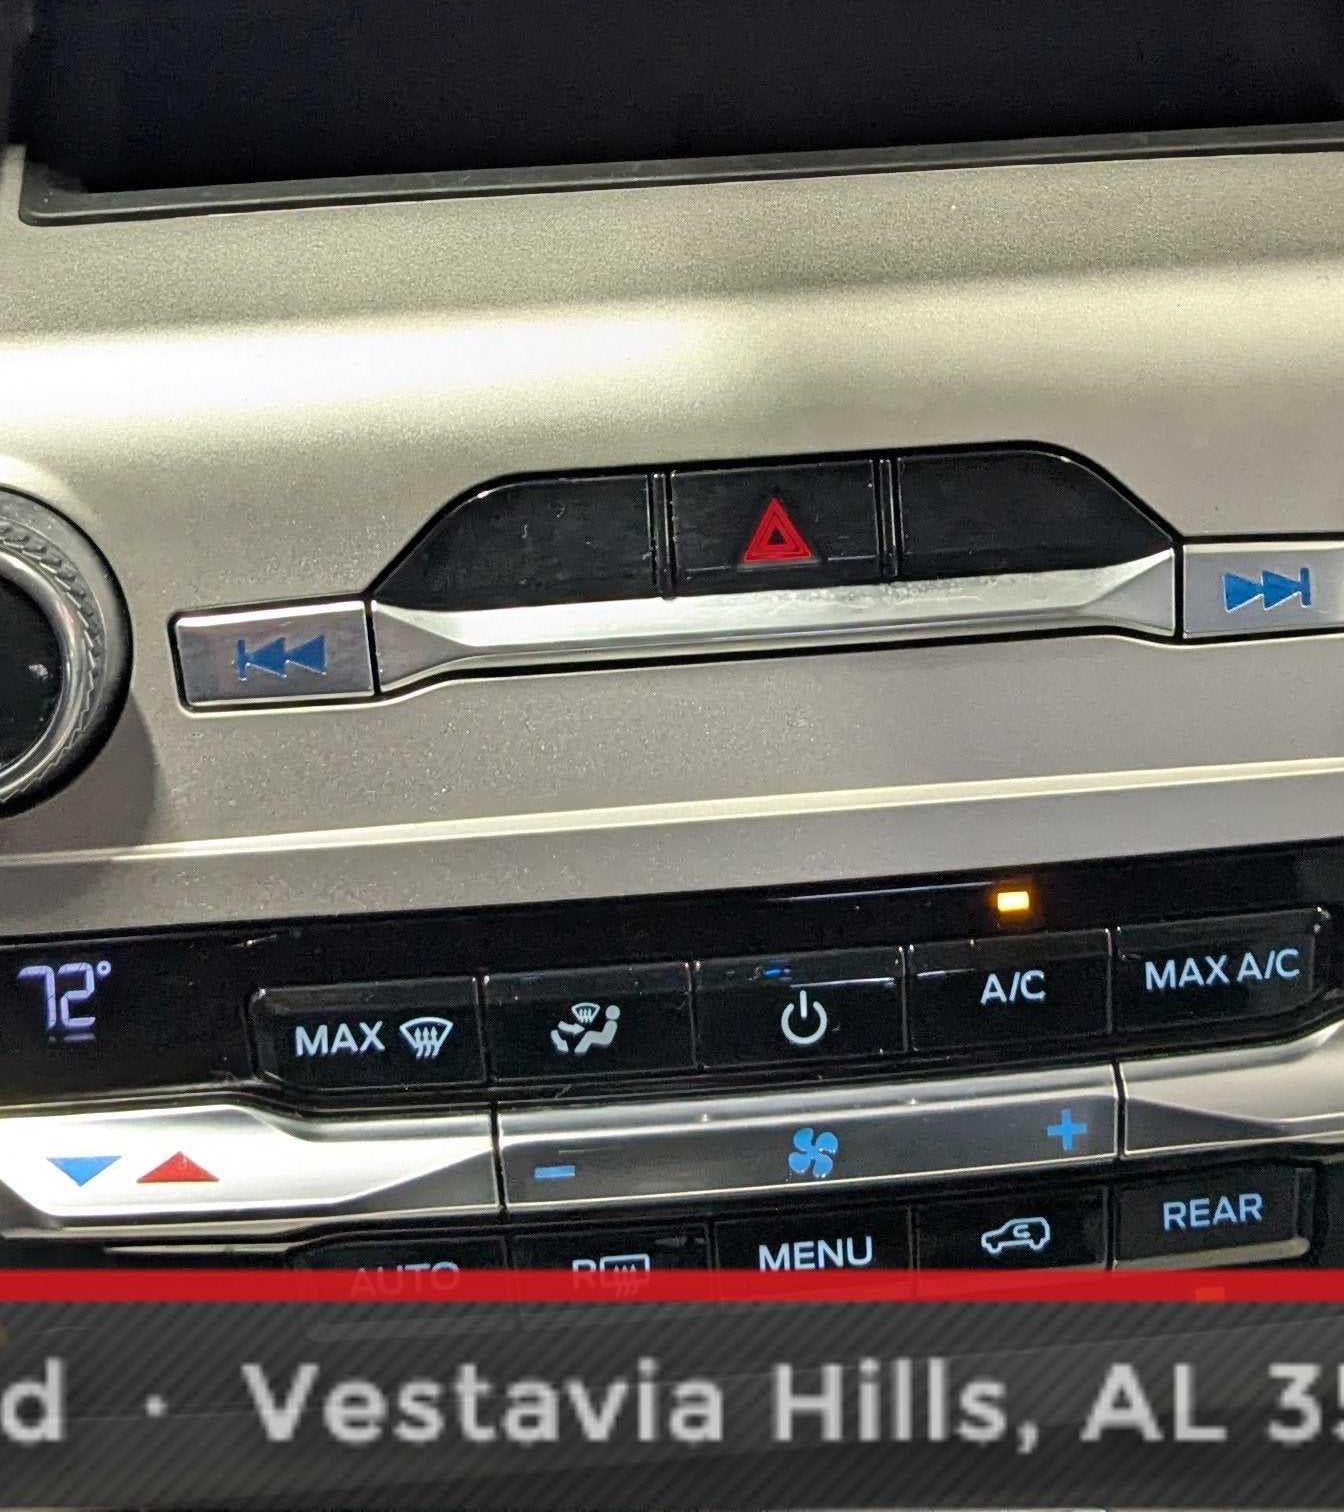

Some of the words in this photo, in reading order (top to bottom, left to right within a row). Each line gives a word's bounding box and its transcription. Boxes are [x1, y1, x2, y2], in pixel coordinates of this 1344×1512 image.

[980, 968, 1047, 1006] A/C
[1144, 952, 1229, 990] MAX
[1236, 947, 1301, 982] A/C
[294, 1018, 387, 1059] MAX
[1162, 1192, 1264, 1232] REAR
[757, 1235, 874, 1273] MENU
[353, 1260, 462, 1298] AUTO
